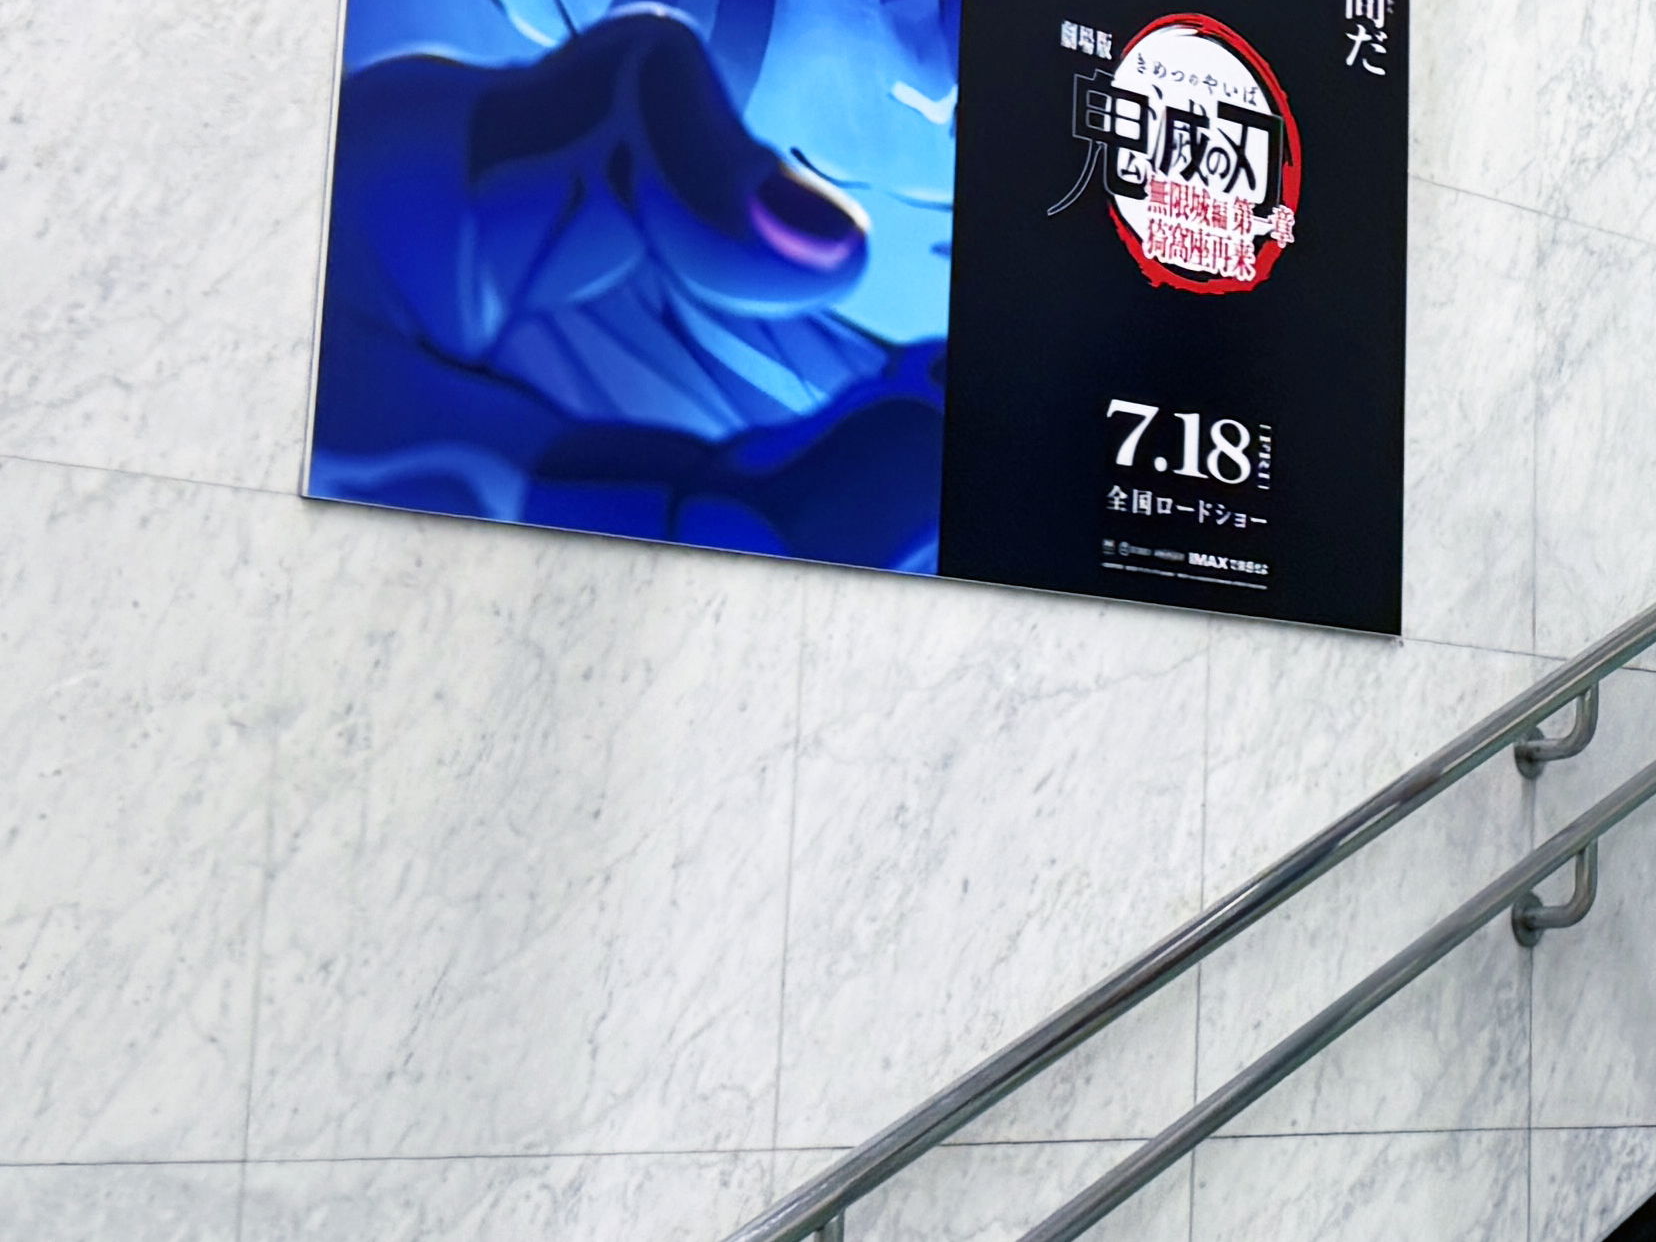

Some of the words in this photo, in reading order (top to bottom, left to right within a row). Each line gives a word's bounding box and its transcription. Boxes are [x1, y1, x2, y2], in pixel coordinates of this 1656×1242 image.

[1136, 52, 1259, 106] きめつのやいば
[1047, 68, 1284, 217] 鬼滅の刃
[1106, 398, 1252, 485] 7.18
[1105, 485, 1268, 528] 全国ロードショー
